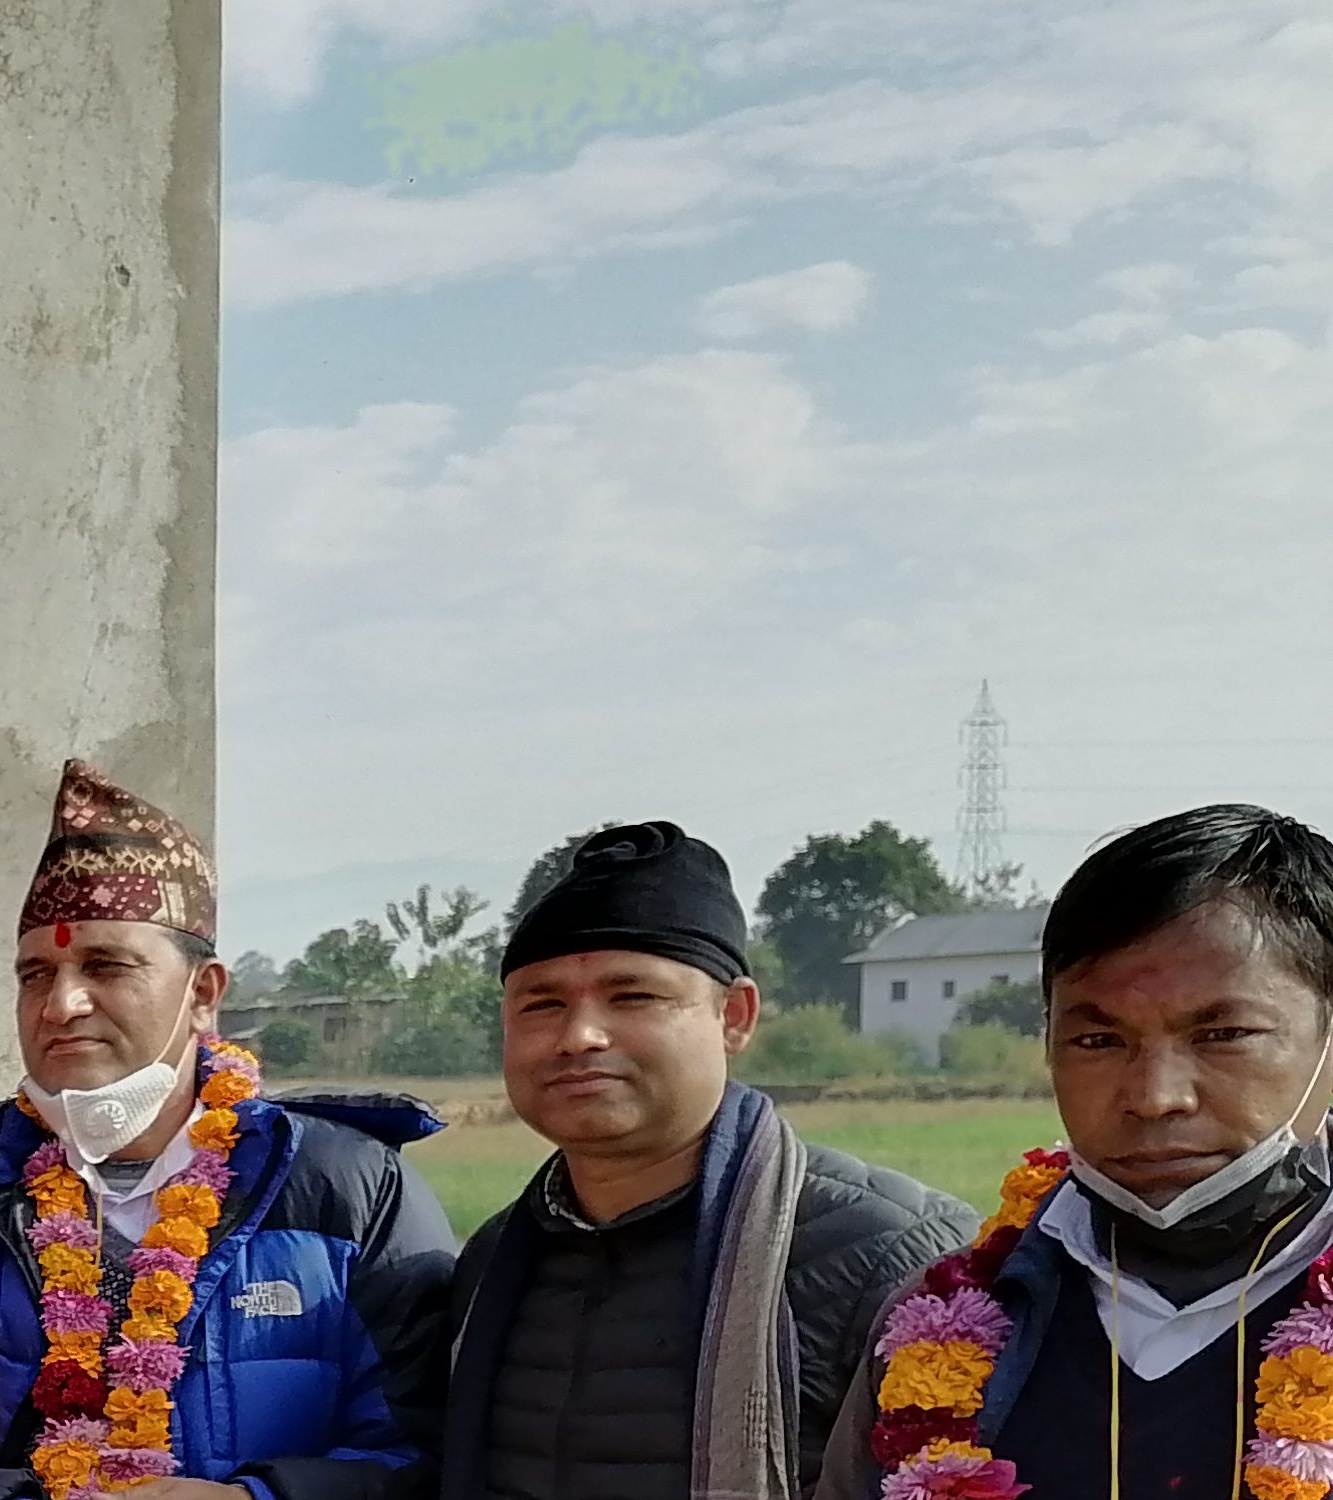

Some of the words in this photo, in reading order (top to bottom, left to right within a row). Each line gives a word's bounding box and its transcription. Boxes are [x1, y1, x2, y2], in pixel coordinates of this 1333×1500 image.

[247, 1281, 277, 1295] THE
[230, 1293, 277, 1311] NORTH
[245, 1304, 277, 1319] FACE
